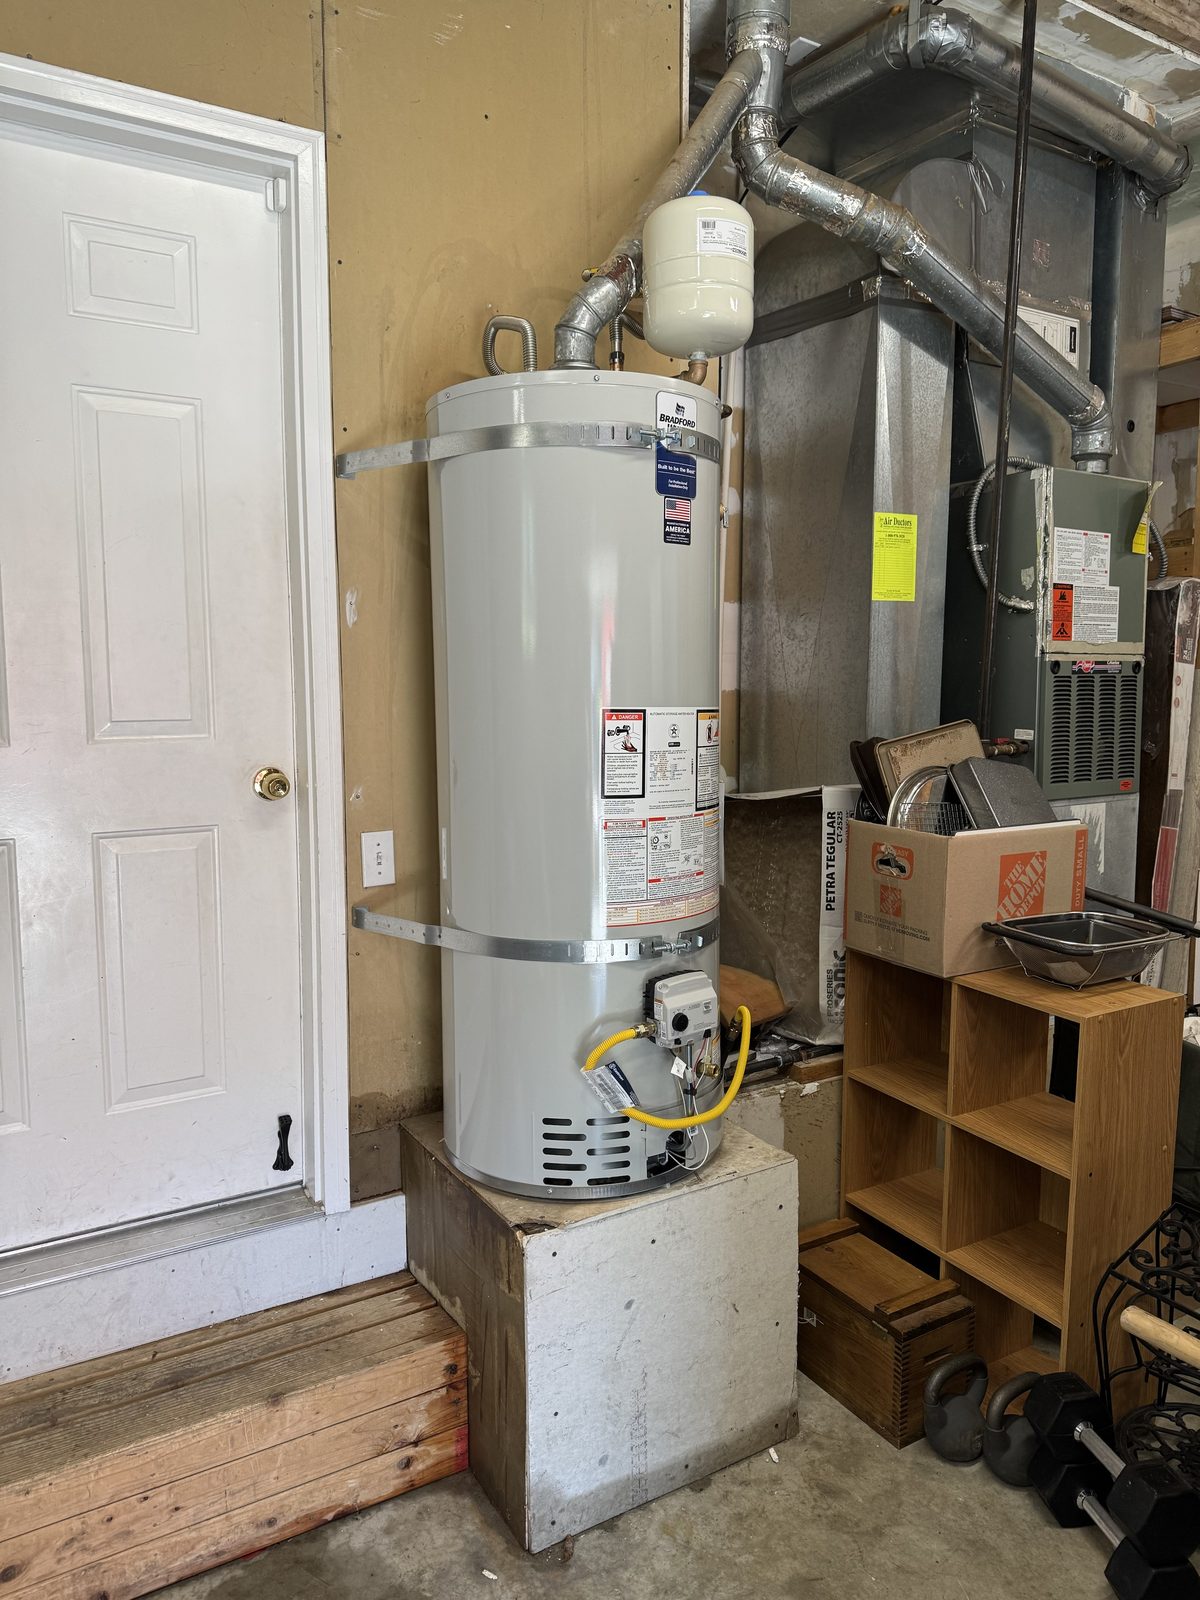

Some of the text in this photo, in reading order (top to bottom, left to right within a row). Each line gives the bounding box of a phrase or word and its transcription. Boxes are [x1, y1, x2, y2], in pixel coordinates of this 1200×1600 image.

[659, 413, 696, 429] BRADFORD
[665, 525, 690, 535] AMERICA
[883, 516, 892, 526] Air
[893, 517, 912, 527] Doctors
[825, 810, 836, 912] PETRA TEGULAR
[1004, 861, 1025, 888] THE
[1076, 836, 1085, 877] SMALL
[996, 851, 1047, 920] HOME
[1014, 875, 1045, 918] DEPOT
[826, 969, 834, 1017] PROSERIES
